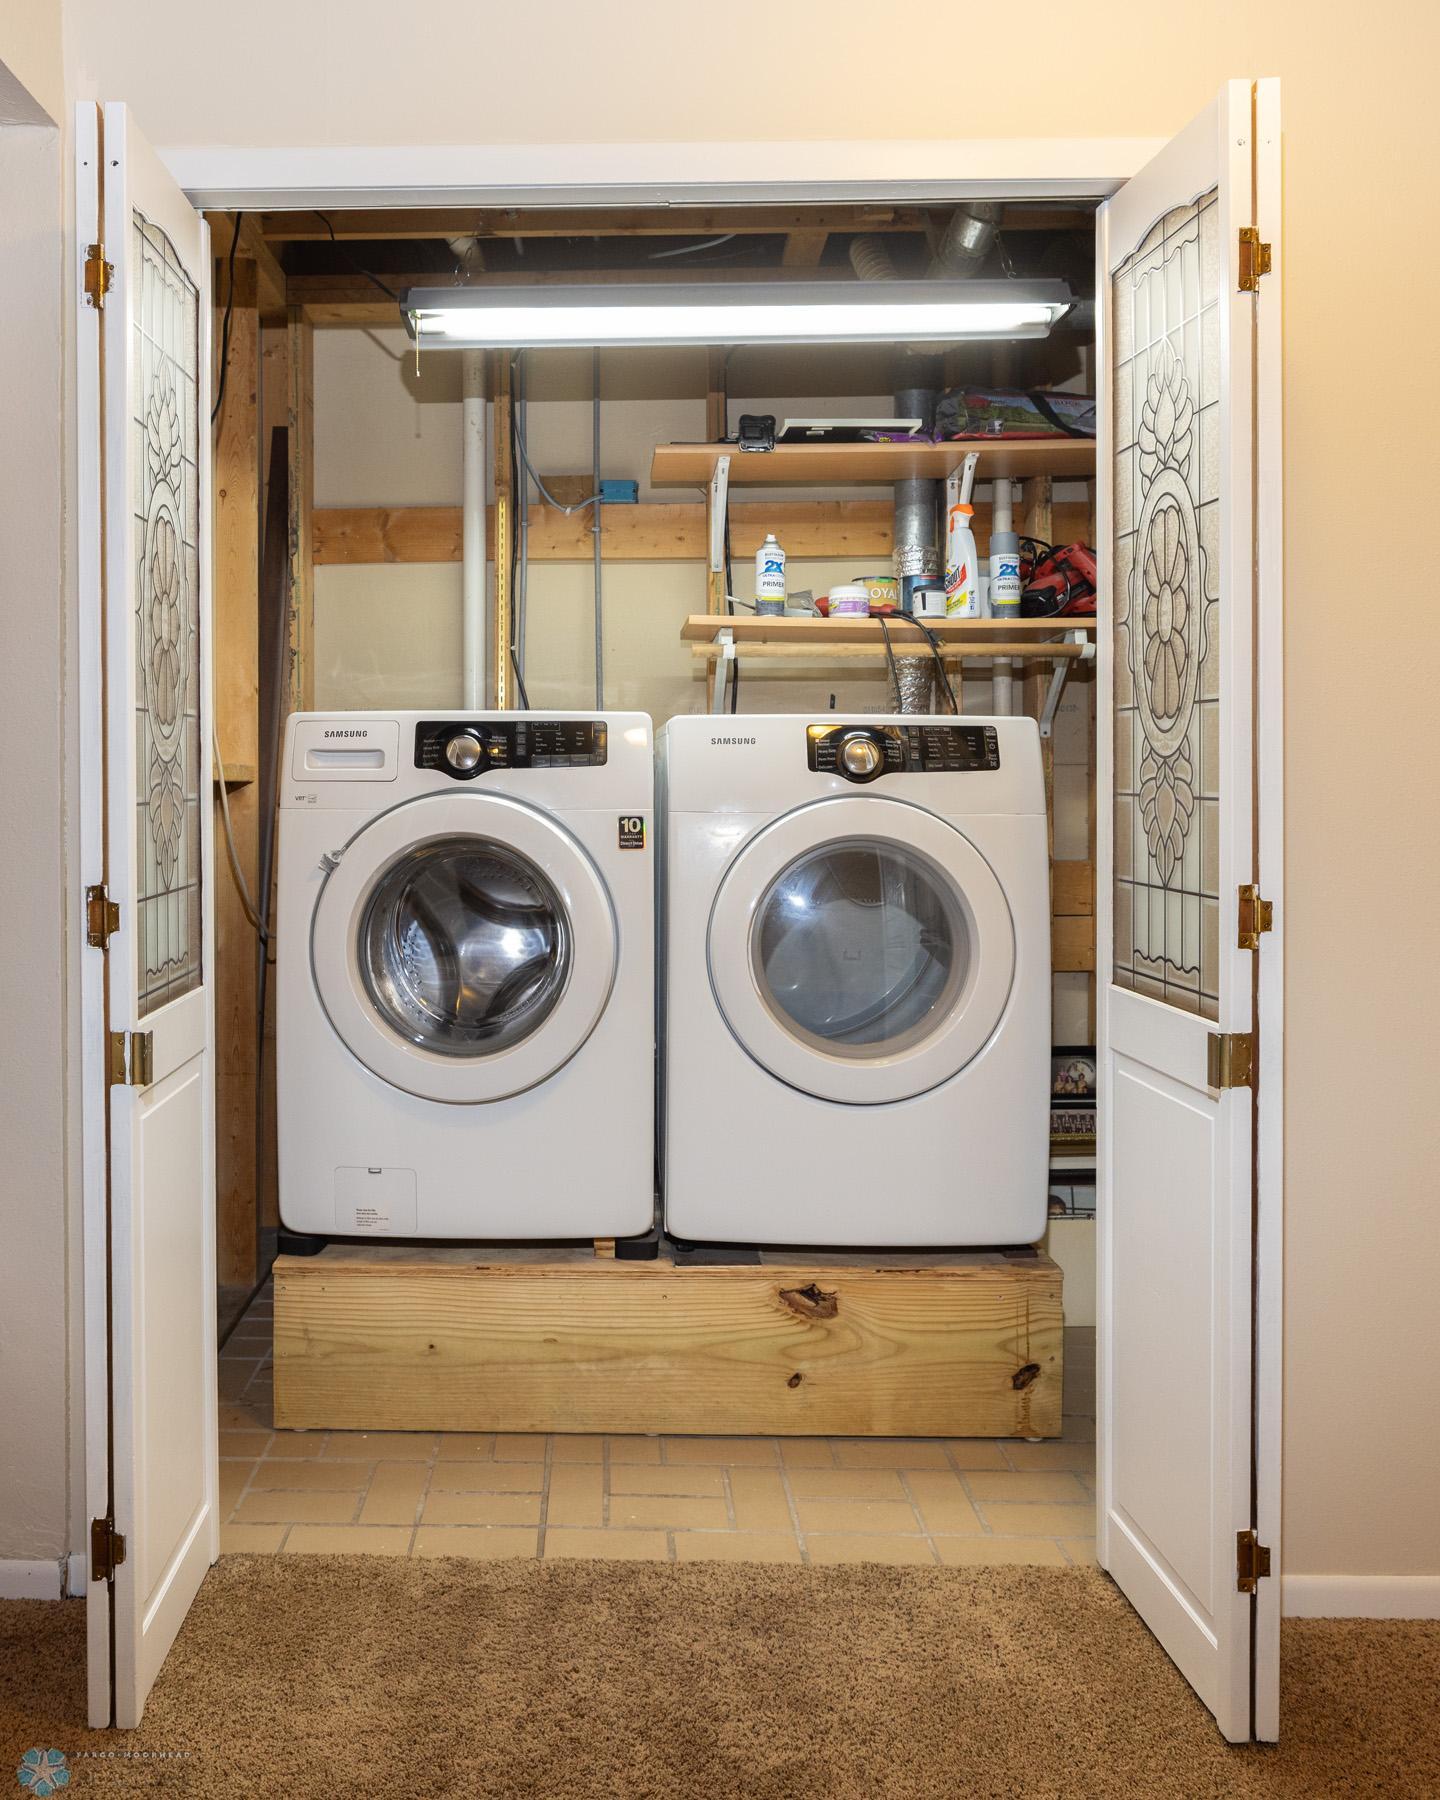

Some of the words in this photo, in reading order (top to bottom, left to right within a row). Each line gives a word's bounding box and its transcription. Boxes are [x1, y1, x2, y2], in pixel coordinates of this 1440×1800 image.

[764, 559, 783, 573] 2X
[999, 563, 1018, 577] 2X
[324, 730, 368, 738] SAMSUNG
[711, 737, 756, 745] SAMSUNG
[621, 818, 641, 832] 10
